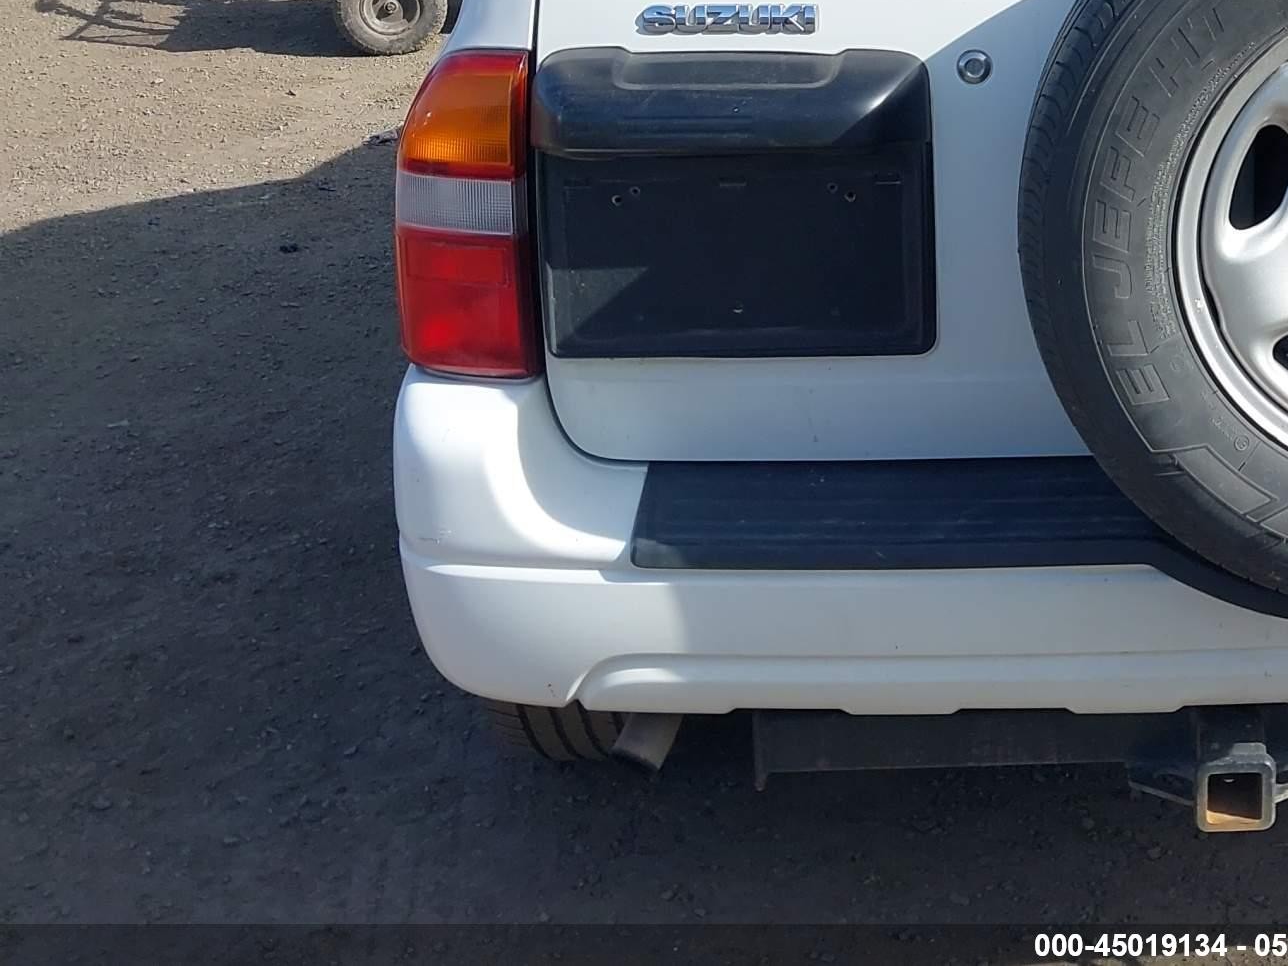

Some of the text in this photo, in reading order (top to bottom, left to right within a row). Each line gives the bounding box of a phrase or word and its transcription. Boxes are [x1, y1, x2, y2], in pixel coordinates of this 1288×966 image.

[640, 4, 817, 35] SUZUKI
[1092, 95, 1160, 299] JEFE
[1107, 320, 1170, 405] EL
